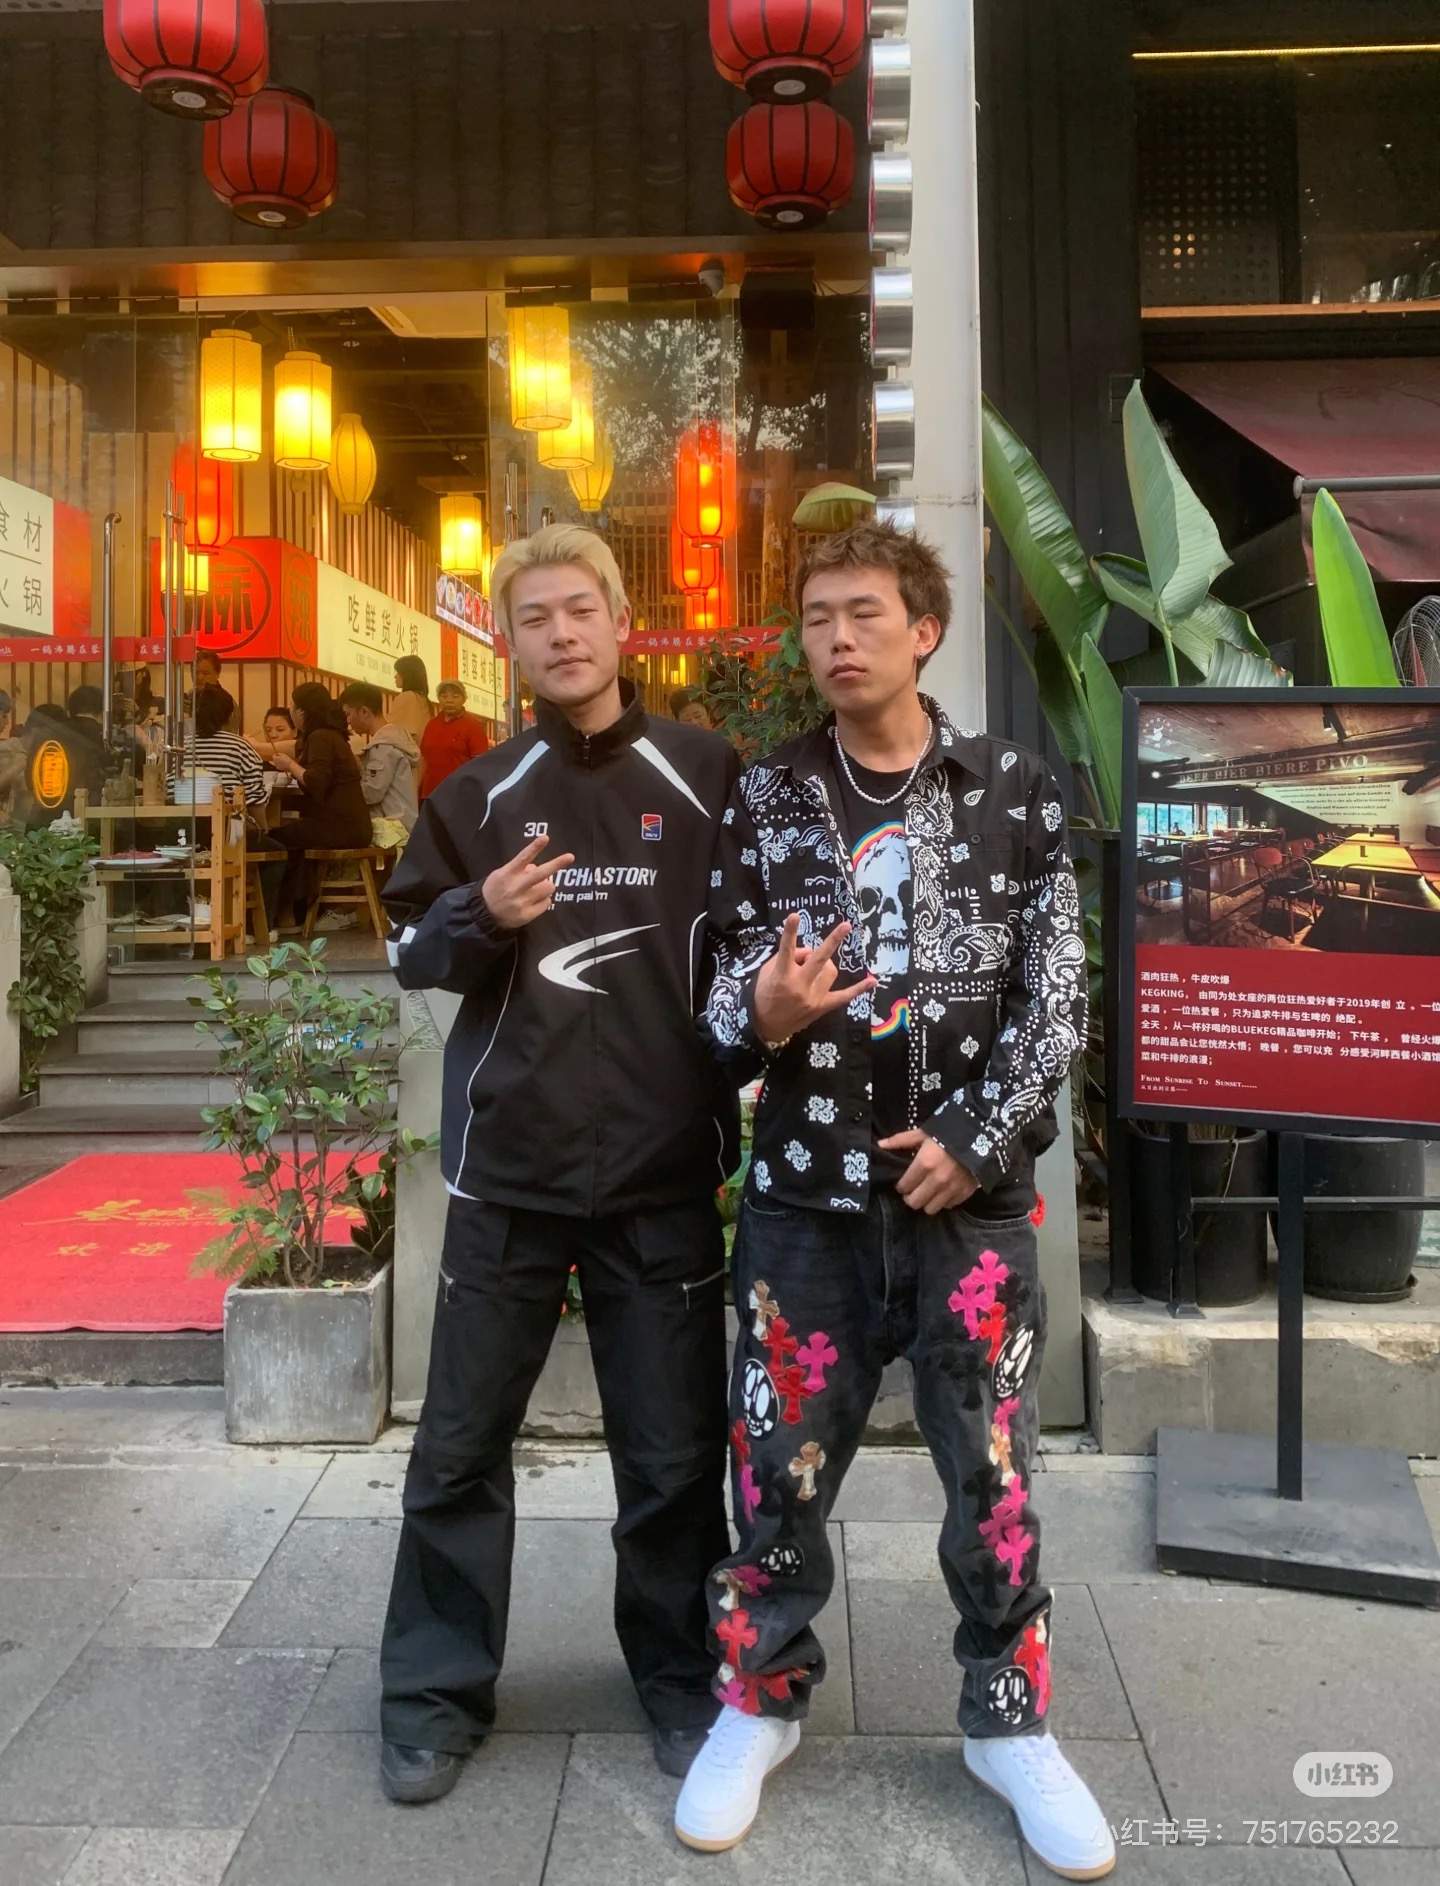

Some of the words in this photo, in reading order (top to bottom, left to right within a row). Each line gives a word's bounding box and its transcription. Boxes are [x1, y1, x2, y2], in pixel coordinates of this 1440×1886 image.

[1256, 760, 1309, 777] BIERE
[1316, 755, 1368, 771] PIVO
[549, 866, 658, 887] TCHASTORY
[555, 892, 574, 902] the
